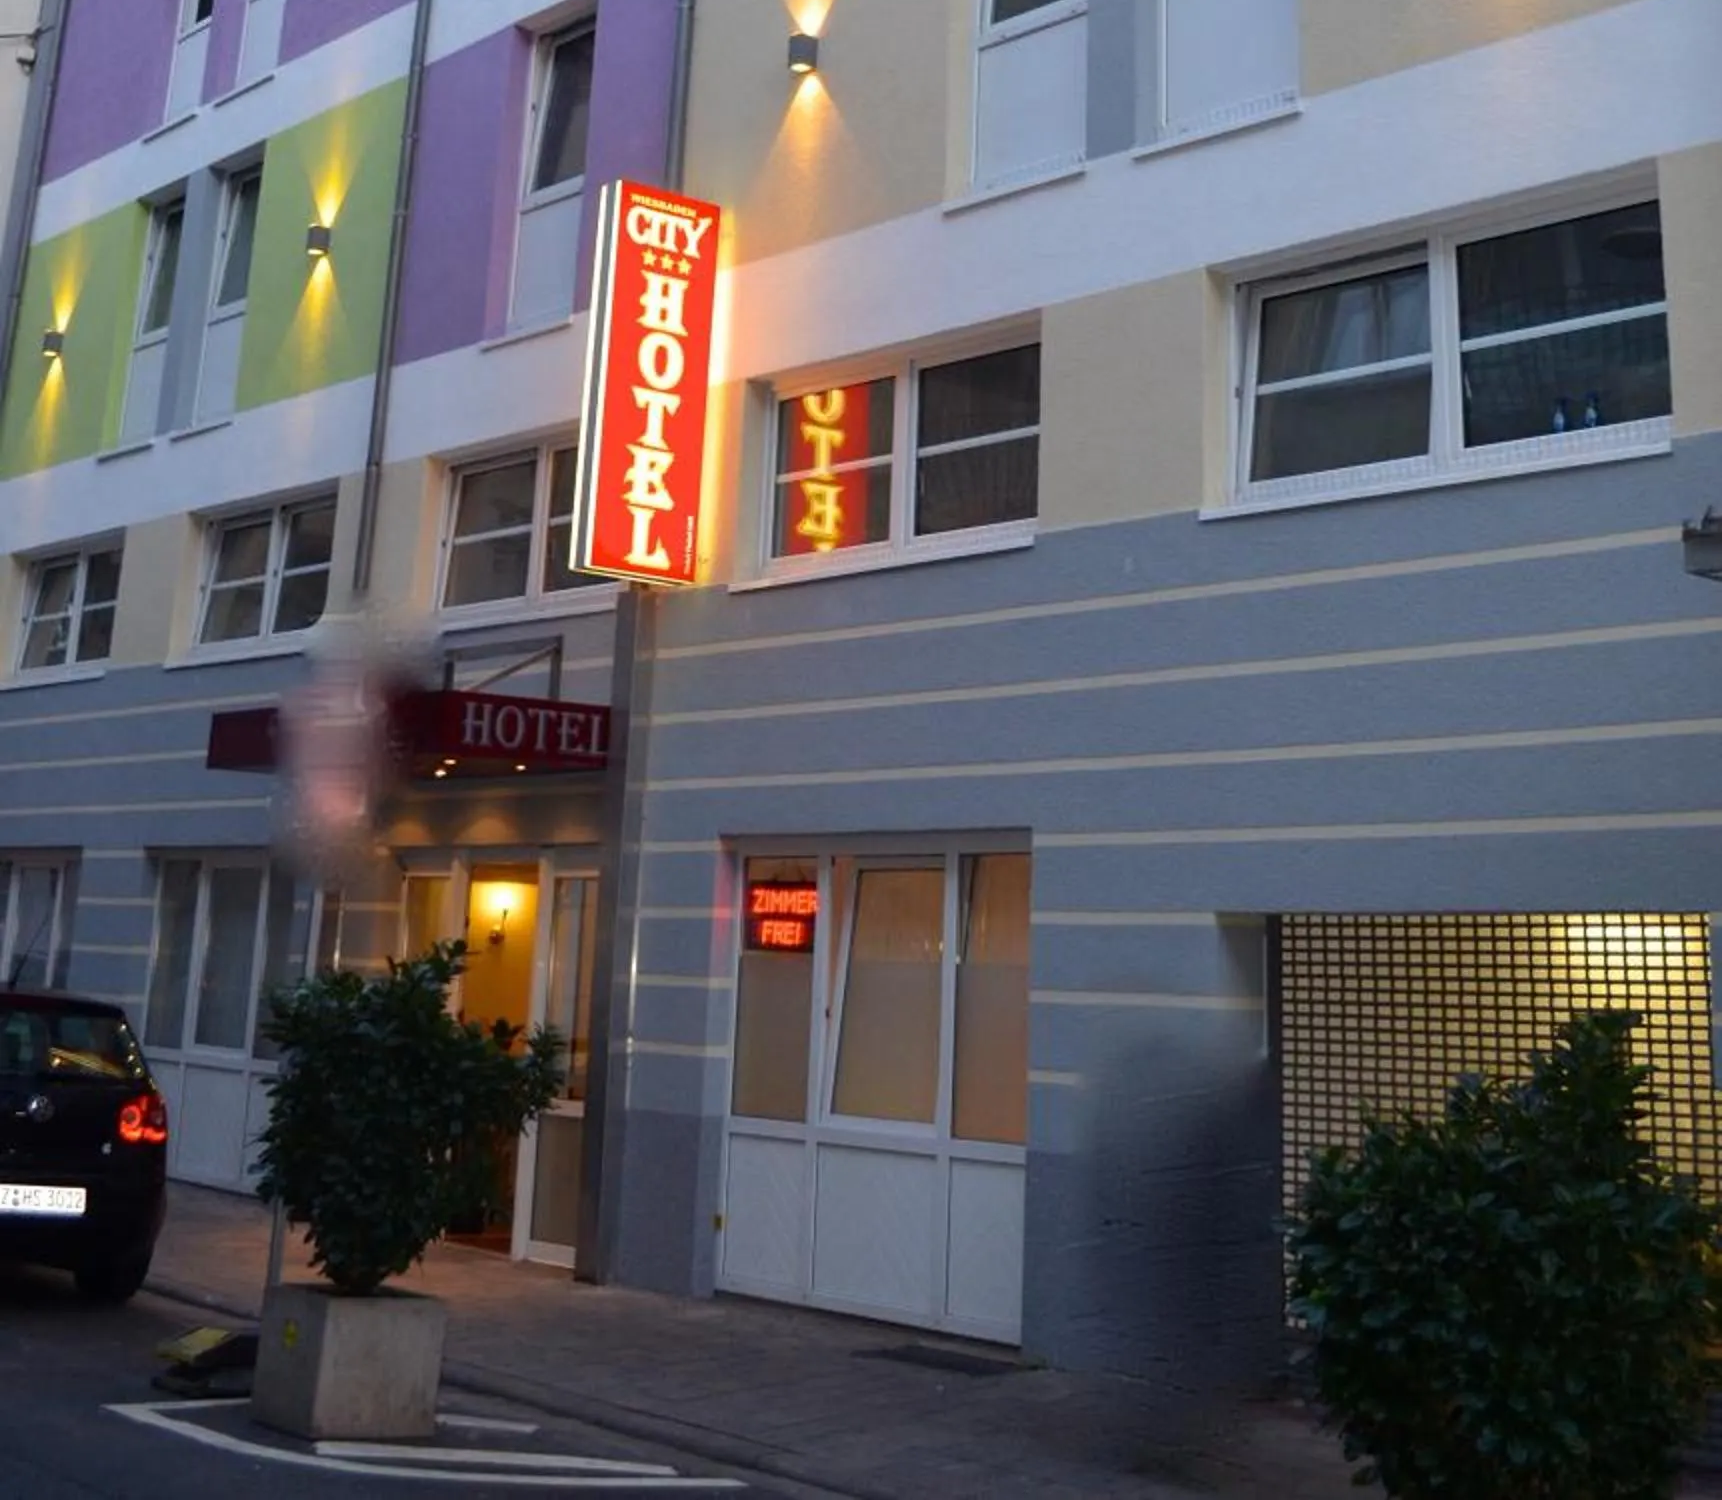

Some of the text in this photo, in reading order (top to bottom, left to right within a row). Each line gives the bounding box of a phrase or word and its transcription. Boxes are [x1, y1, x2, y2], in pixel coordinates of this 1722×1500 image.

[626, 205, 713, 259] CITY
[623, 269, 689, 572] HOTEL
[461, 701, 607, 756] HOTEL
[752, 888, 820, 913] ZIMMER
[761, 921, 803, 945] FREI
